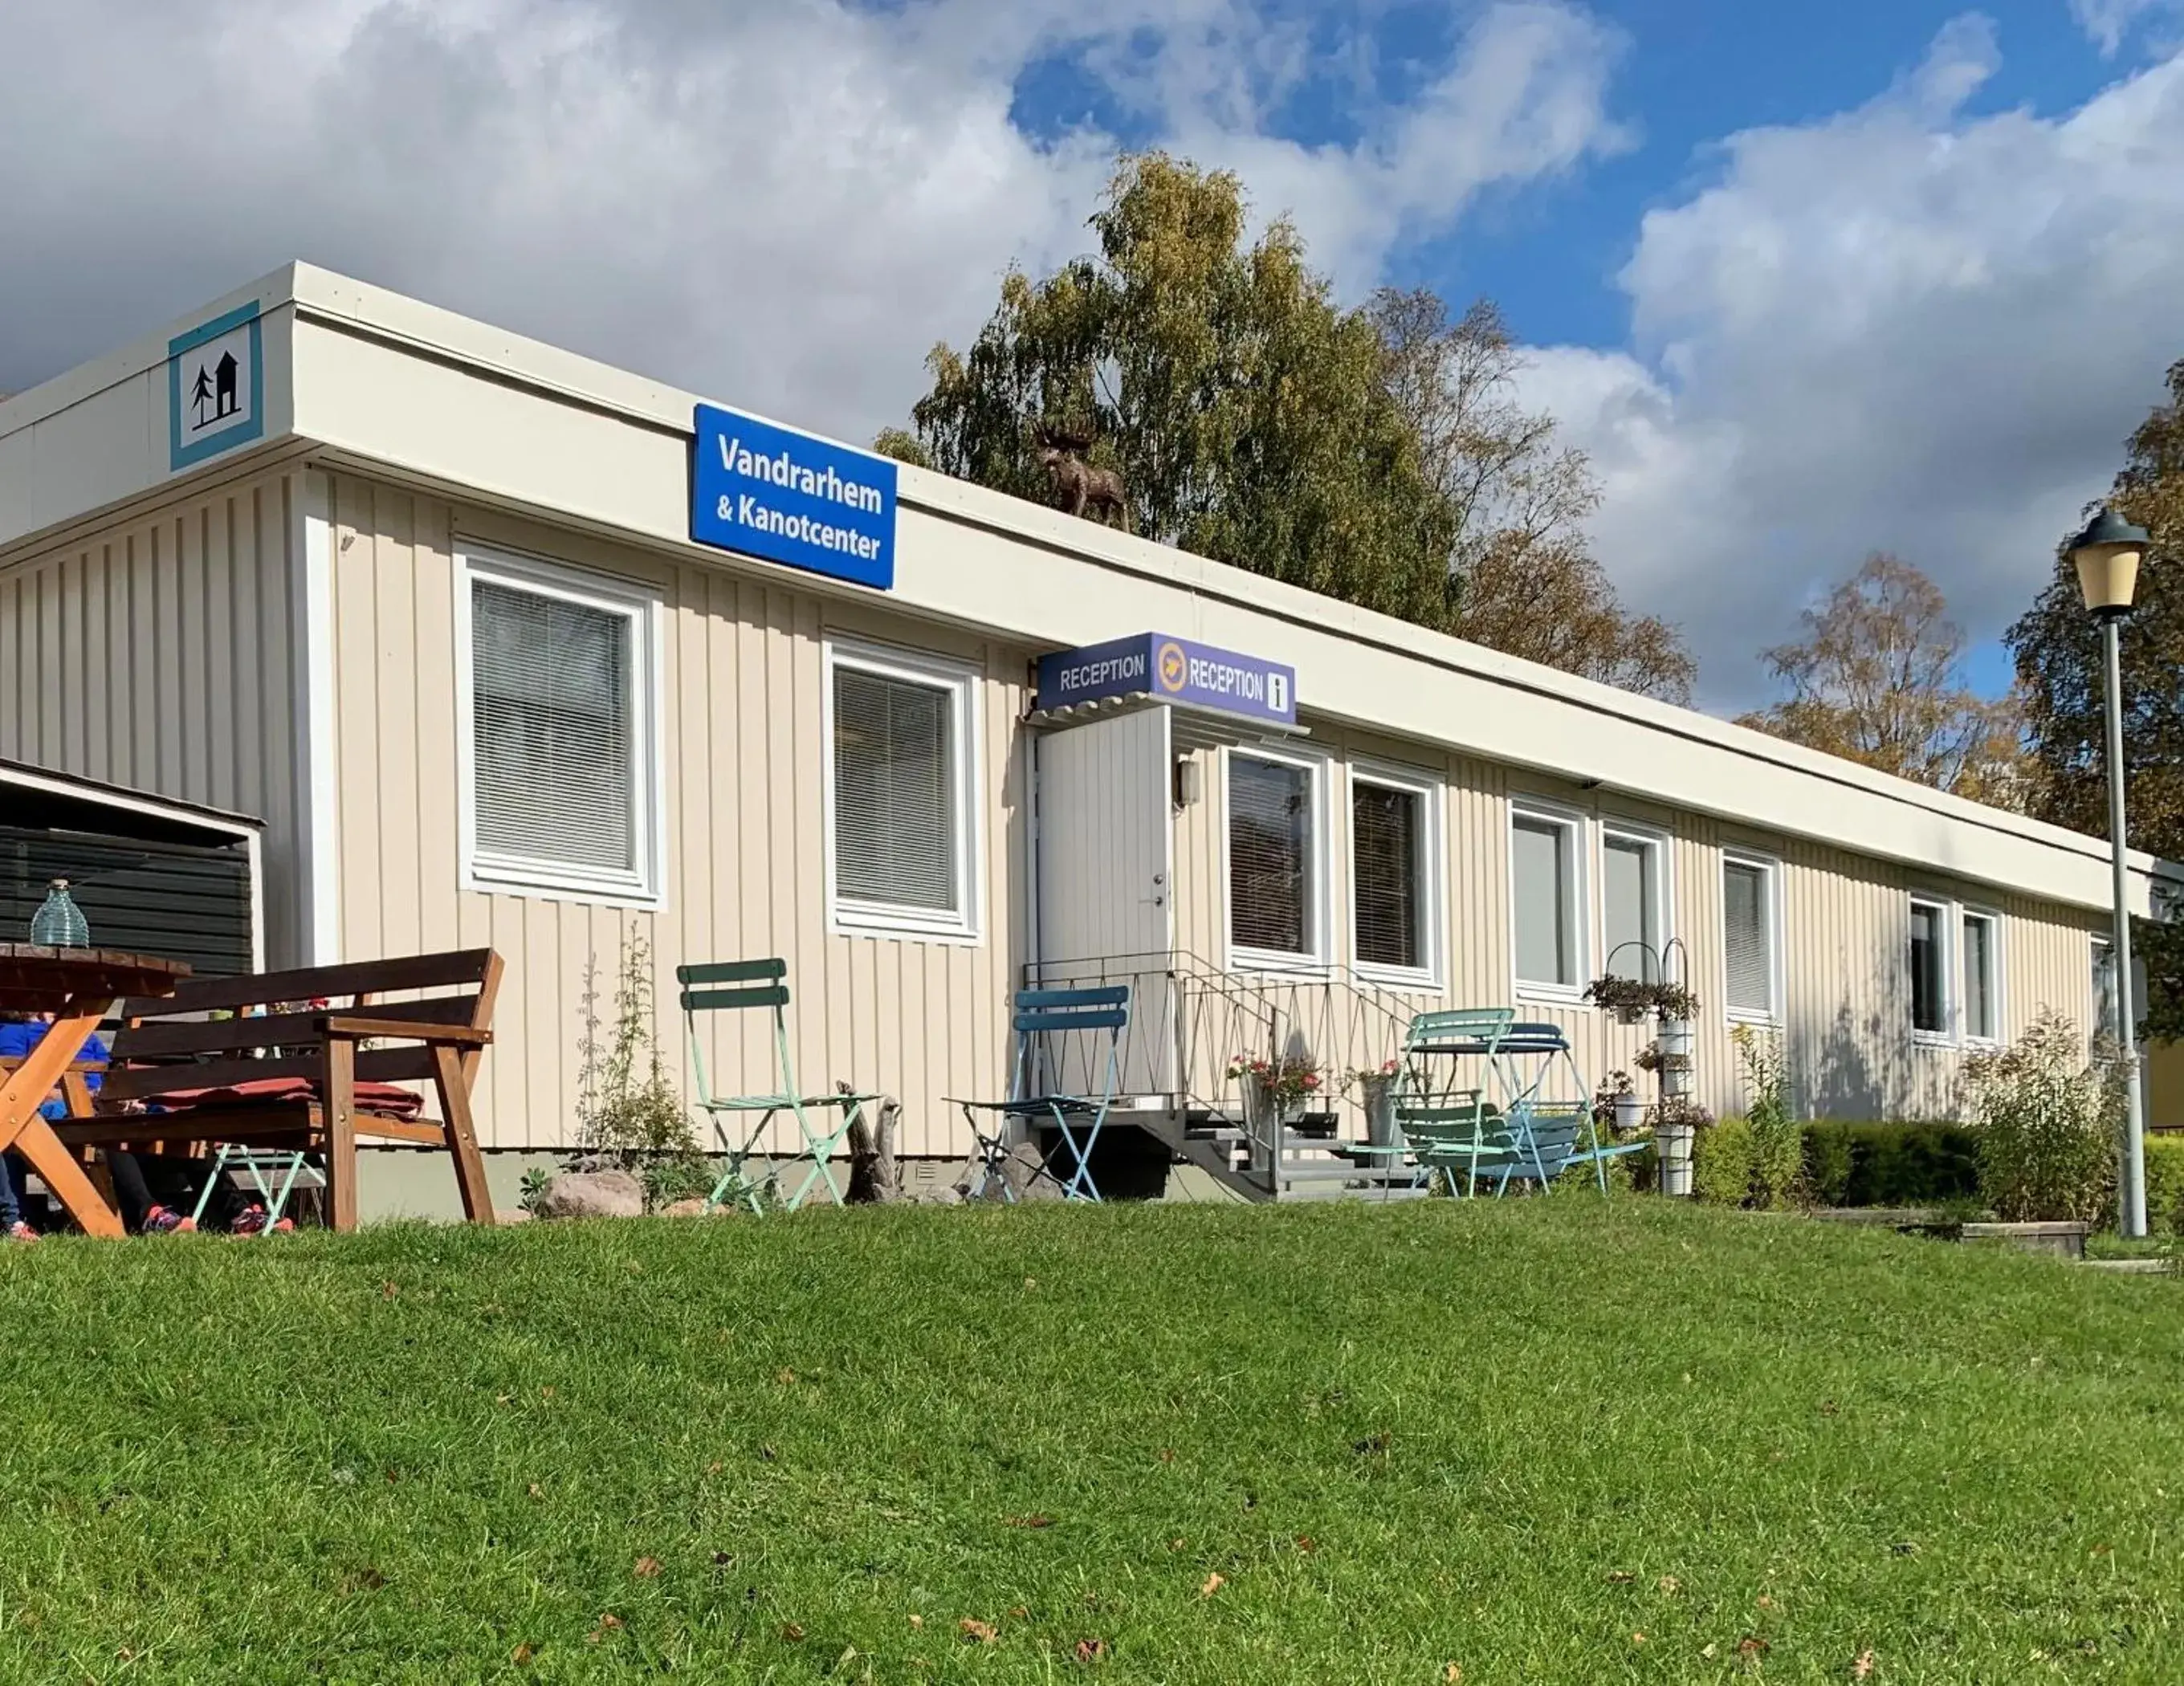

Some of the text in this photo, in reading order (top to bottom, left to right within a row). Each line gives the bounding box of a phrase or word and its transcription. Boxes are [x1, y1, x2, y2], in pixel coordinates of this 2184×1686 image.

[719, 434, 882, 515] Vandrarhem
[717, 493, 880, 560] & Kanotcenter
[1061, 654, 1144, 691] RECEPTION
[1190, 658, 1263, 701] RECEPTION
